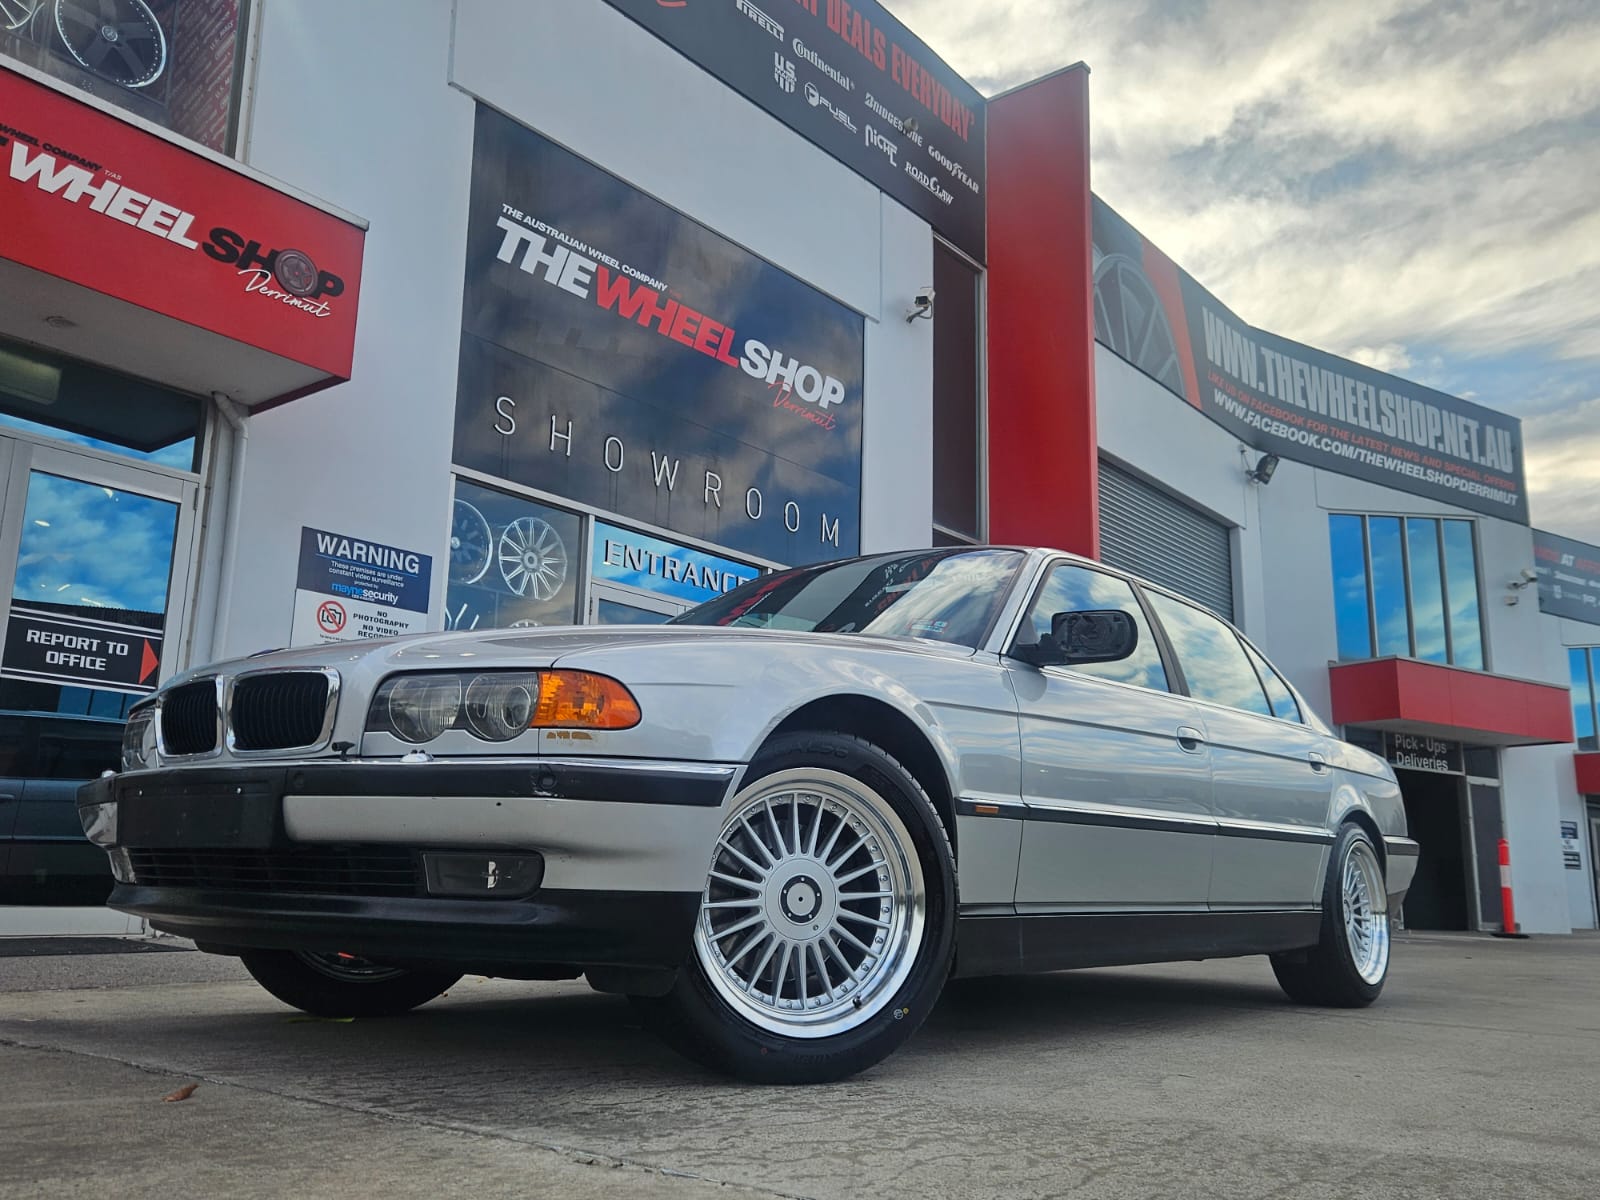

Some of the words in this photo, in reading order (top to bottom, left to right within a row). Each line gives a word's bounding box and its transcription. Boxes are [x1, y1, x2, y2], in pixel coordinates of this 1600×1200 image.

[736, 0, 784, 42] PIRELLI
[826, 0, 887, 72] DEALS
[793, 38, 851, 91] Continental
[864, 91, 923, 147] BRIDGESONE
[42, 142, 102, 171] COMPANY
[928, 145, 979, 194] GOODYEAR
[9, 140, 199, 250] WHEEL
[502, 203, 524, 221] THE
[523, 215, 587, 253] AUSTRALIAN
[588, 246, 620, 270] WHEEL
[621, 264, 668, 292] COMPANY
[238, 268, 331, 318] Derrimut
[739, 339, 845, 409] SHOP
[1202, 306, 1515, 474] WWW.THEWHEELSHOP.NET.AU
[1251, 398, 1305, 428] FACEBOOK
[1307, 419, 1328, 435] FOR
[1330, 426, 1350, 442] THE
[1351, 433, 1389, 452] LATEST
[1421, 454, 1443, 469] AND
[493, 396, 840, 547] SHOWROOM
[317, 533, 420, 573] WARNING
[331, 560, 348, 569] These
[350, 565, 376, 575] premises
[377, 570, 387, 578] are
[387, 573, 404, 581] under
[329, 567, 354, 577] constant
[355, 571, 371, 580] video
[371, 576, 405, 588] surveillance
[353, 613, 410, 629] PHOTOGRAPHY
[375, 626, 399, 637] VIDEO
[377, 610, 388, 618] NO
[26, 629, 103, 653] REPORT
[106, 641, 129, 657] TO
[45, 650, 107, 672] OFFICE
[1395, 734, 1418, 750] Pick
[1427, 737, 1448, 756] Ups
[1396, 751, 1448, 772] Deliveries
